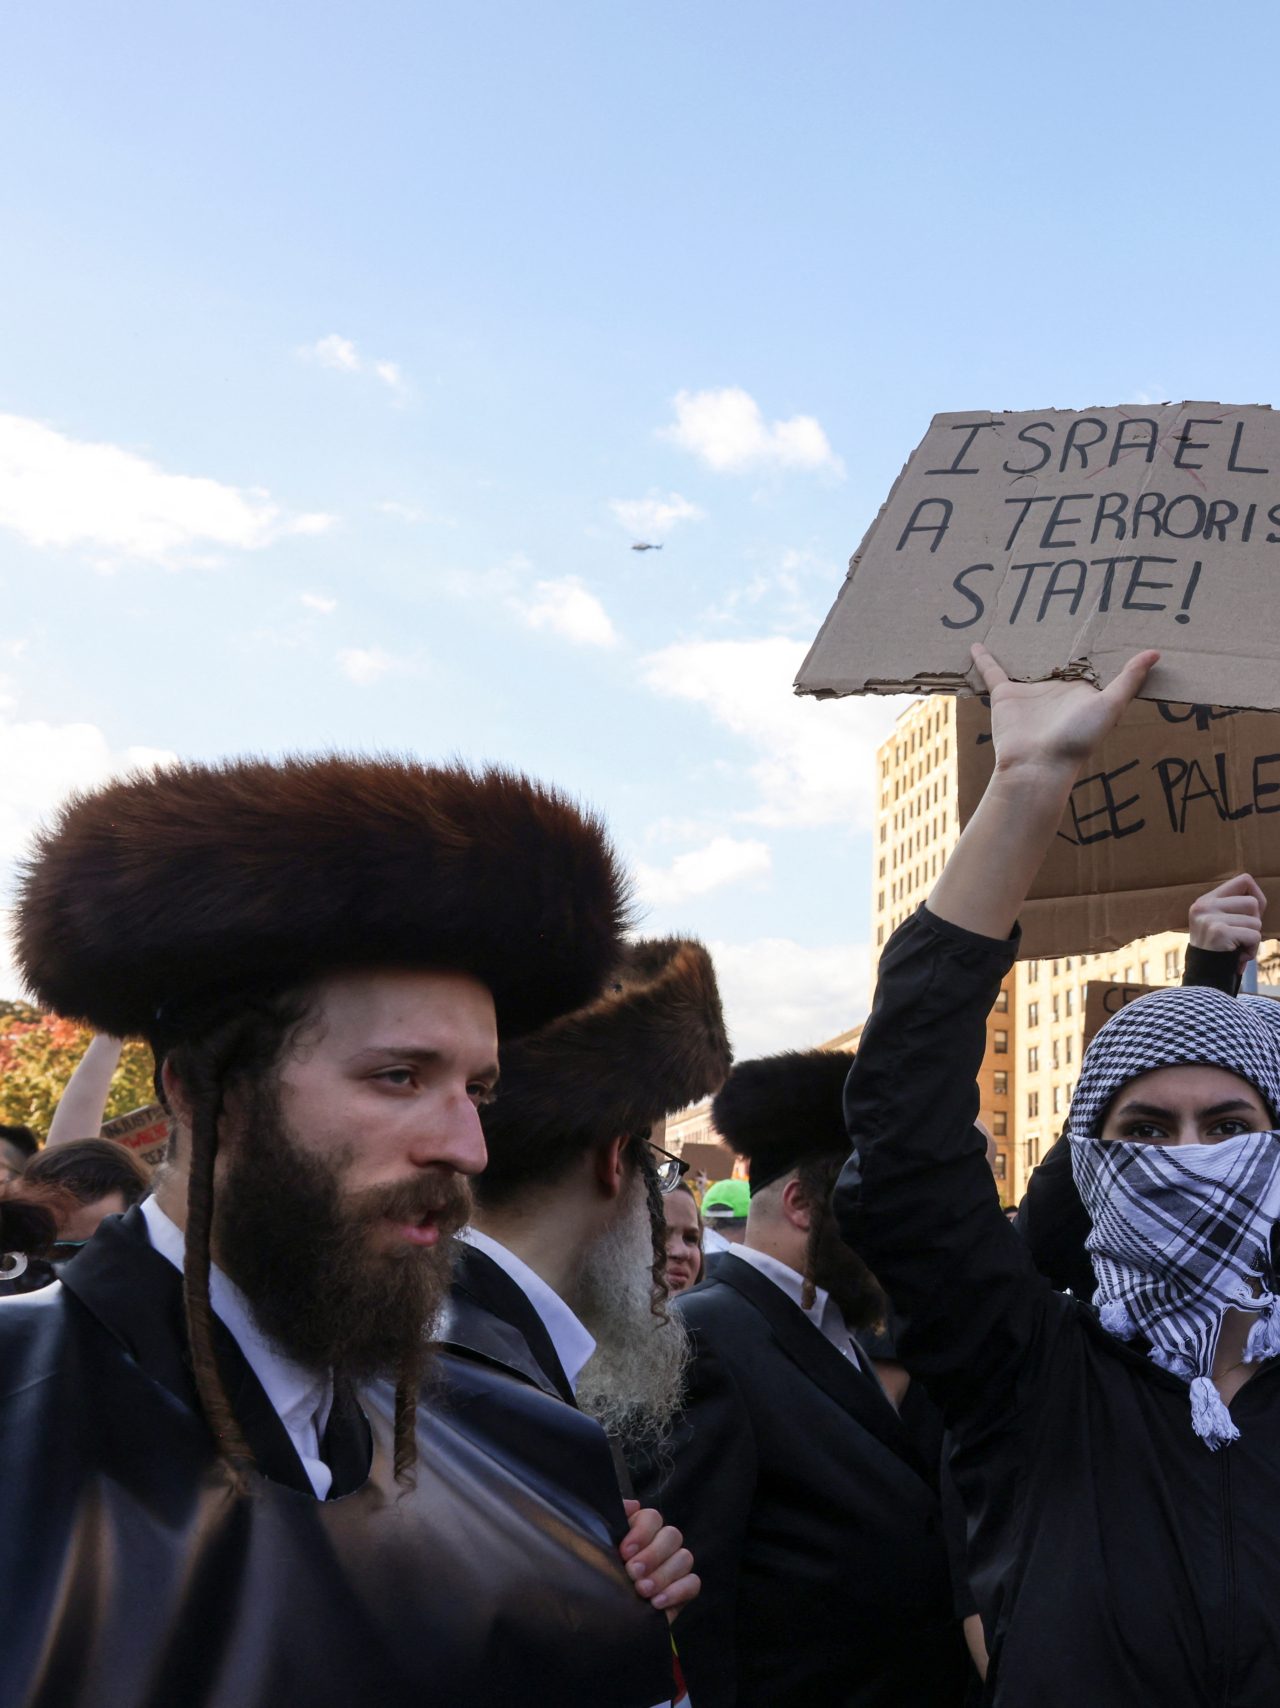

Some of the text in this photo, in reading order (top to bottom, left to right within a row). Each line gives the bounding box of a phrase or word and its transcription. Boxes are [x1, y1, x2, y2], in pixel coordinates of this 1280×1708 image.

[924, 417, 1269, 475] ISRAEL
[896, 497, 954, 553] A
[940, 555, 1203, 630] STATE!
[1057, 758, 1146, 846] EE
